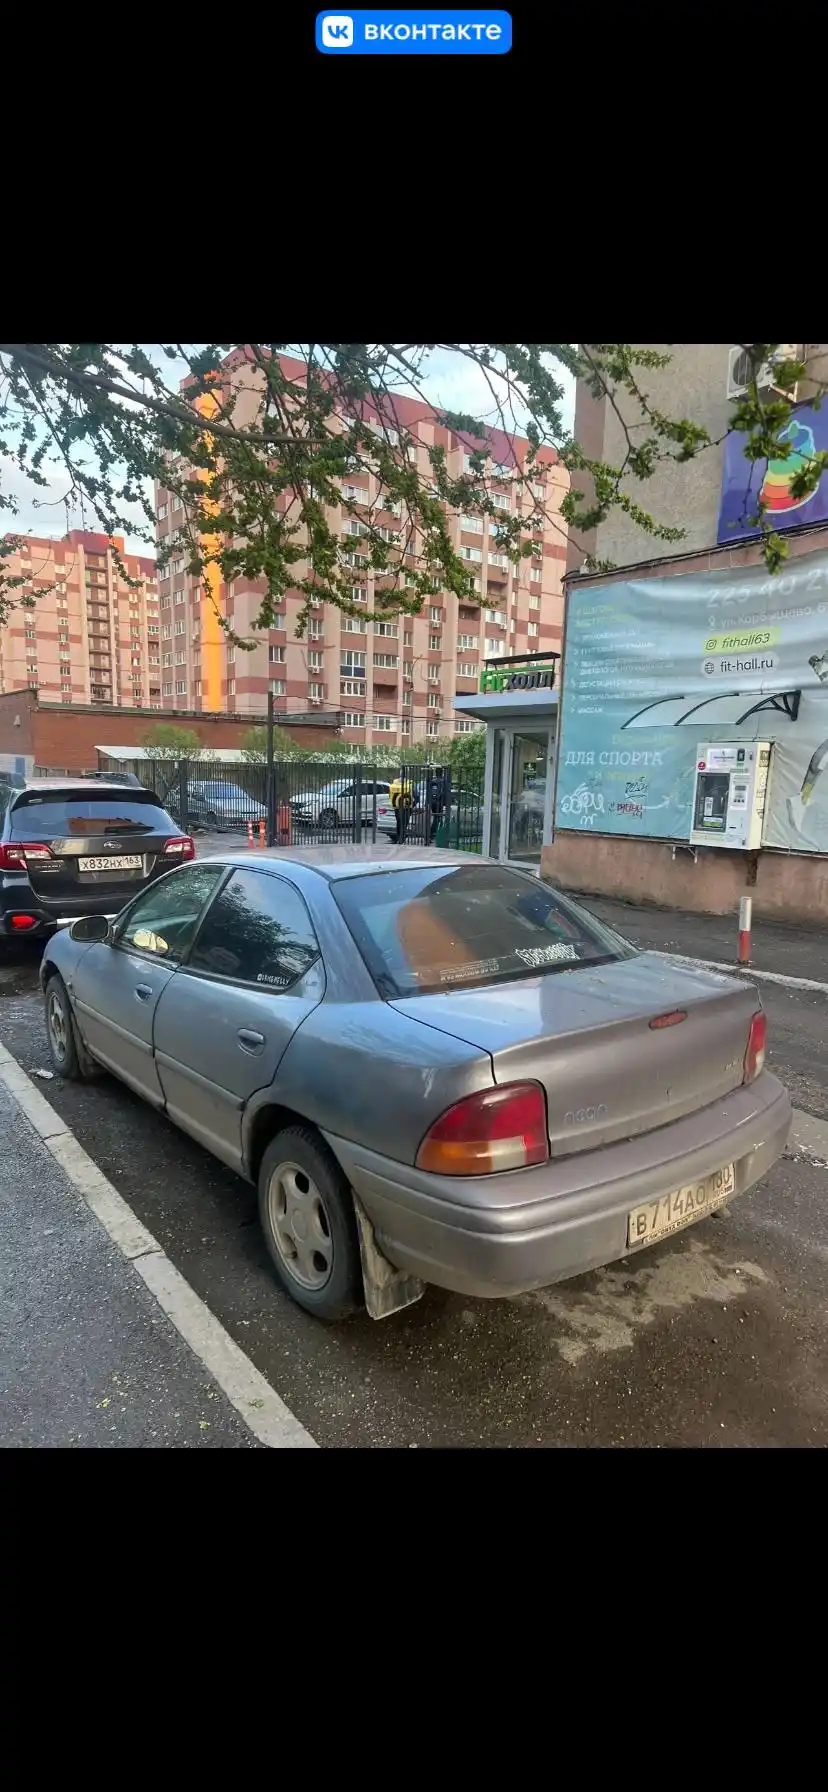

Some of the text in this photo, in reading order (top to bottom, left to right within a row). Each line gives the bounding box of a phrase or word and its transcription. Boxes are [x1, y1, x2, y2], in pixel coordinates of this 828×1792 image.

[806, 568, 828, 591] 2
[721, 633, 771, 649] fithall63
[720, 658, 774, 673] fit-hall.ru
[564, 750, 663, 766] ДЛЯ СПОРТА
[564, 1103, 608, 1125] neon
